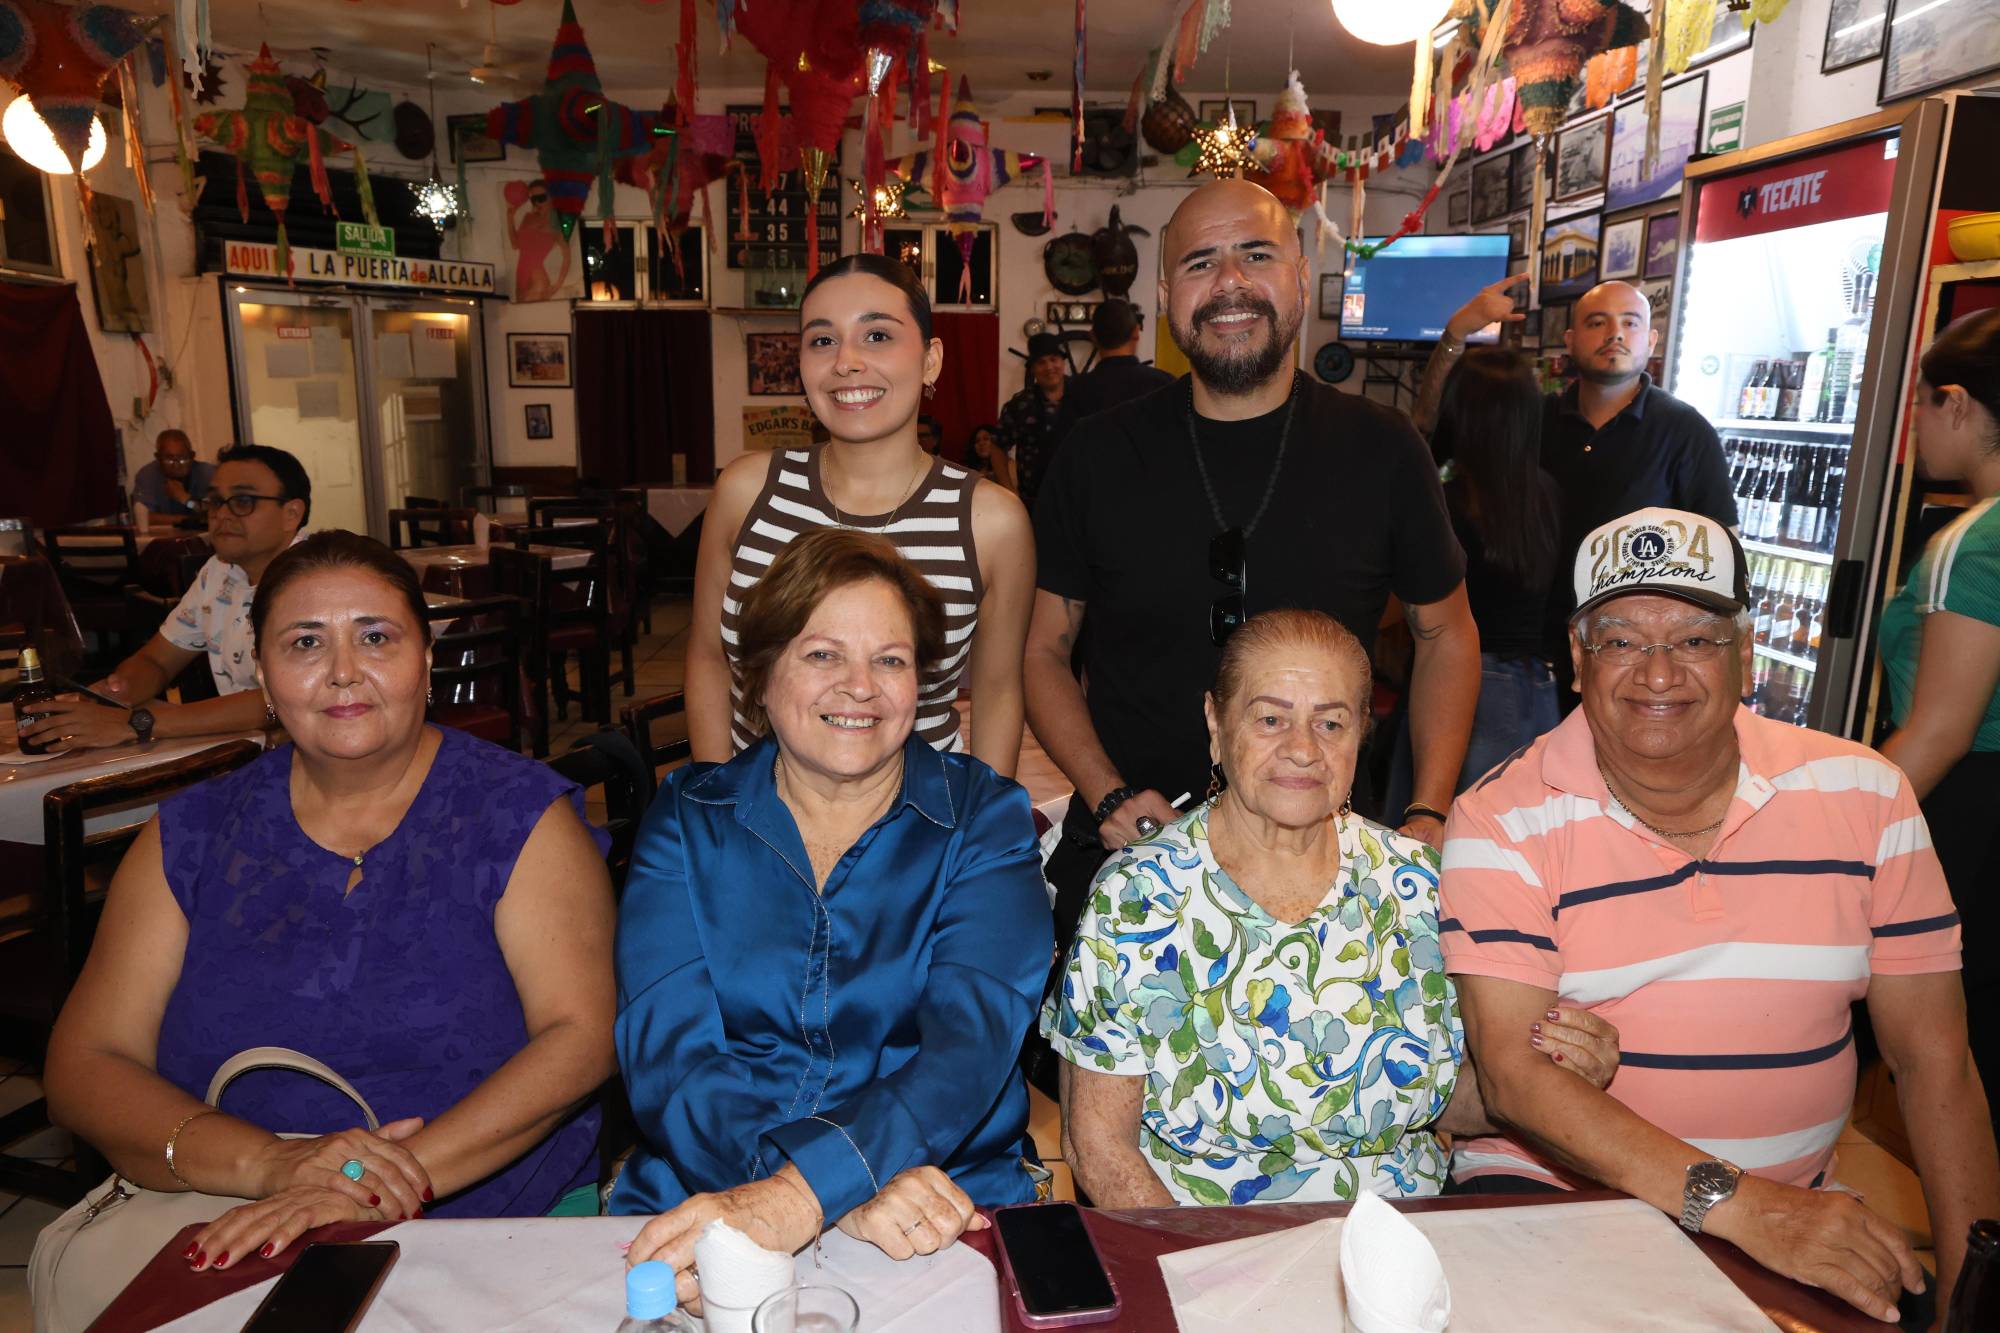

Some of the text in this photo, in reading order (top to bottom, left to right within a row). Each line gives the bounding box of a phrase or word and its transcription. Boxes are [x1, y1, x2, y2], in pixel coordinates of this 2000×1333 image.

[1760, 170, 1829, 214] TECATE
[766, 223, 788, 242] 35
[230, 245, 270, 273] AQUI
[310, 252, 336, 276] LA
[346, 256, 409, 281] PUERTA
[411, 263, 428, 283] de
[428, 264, 493, 288] ALCALA
[747, 415, 799, 436] EDGAR'S
[1637, 535, 1658, 558] LA
